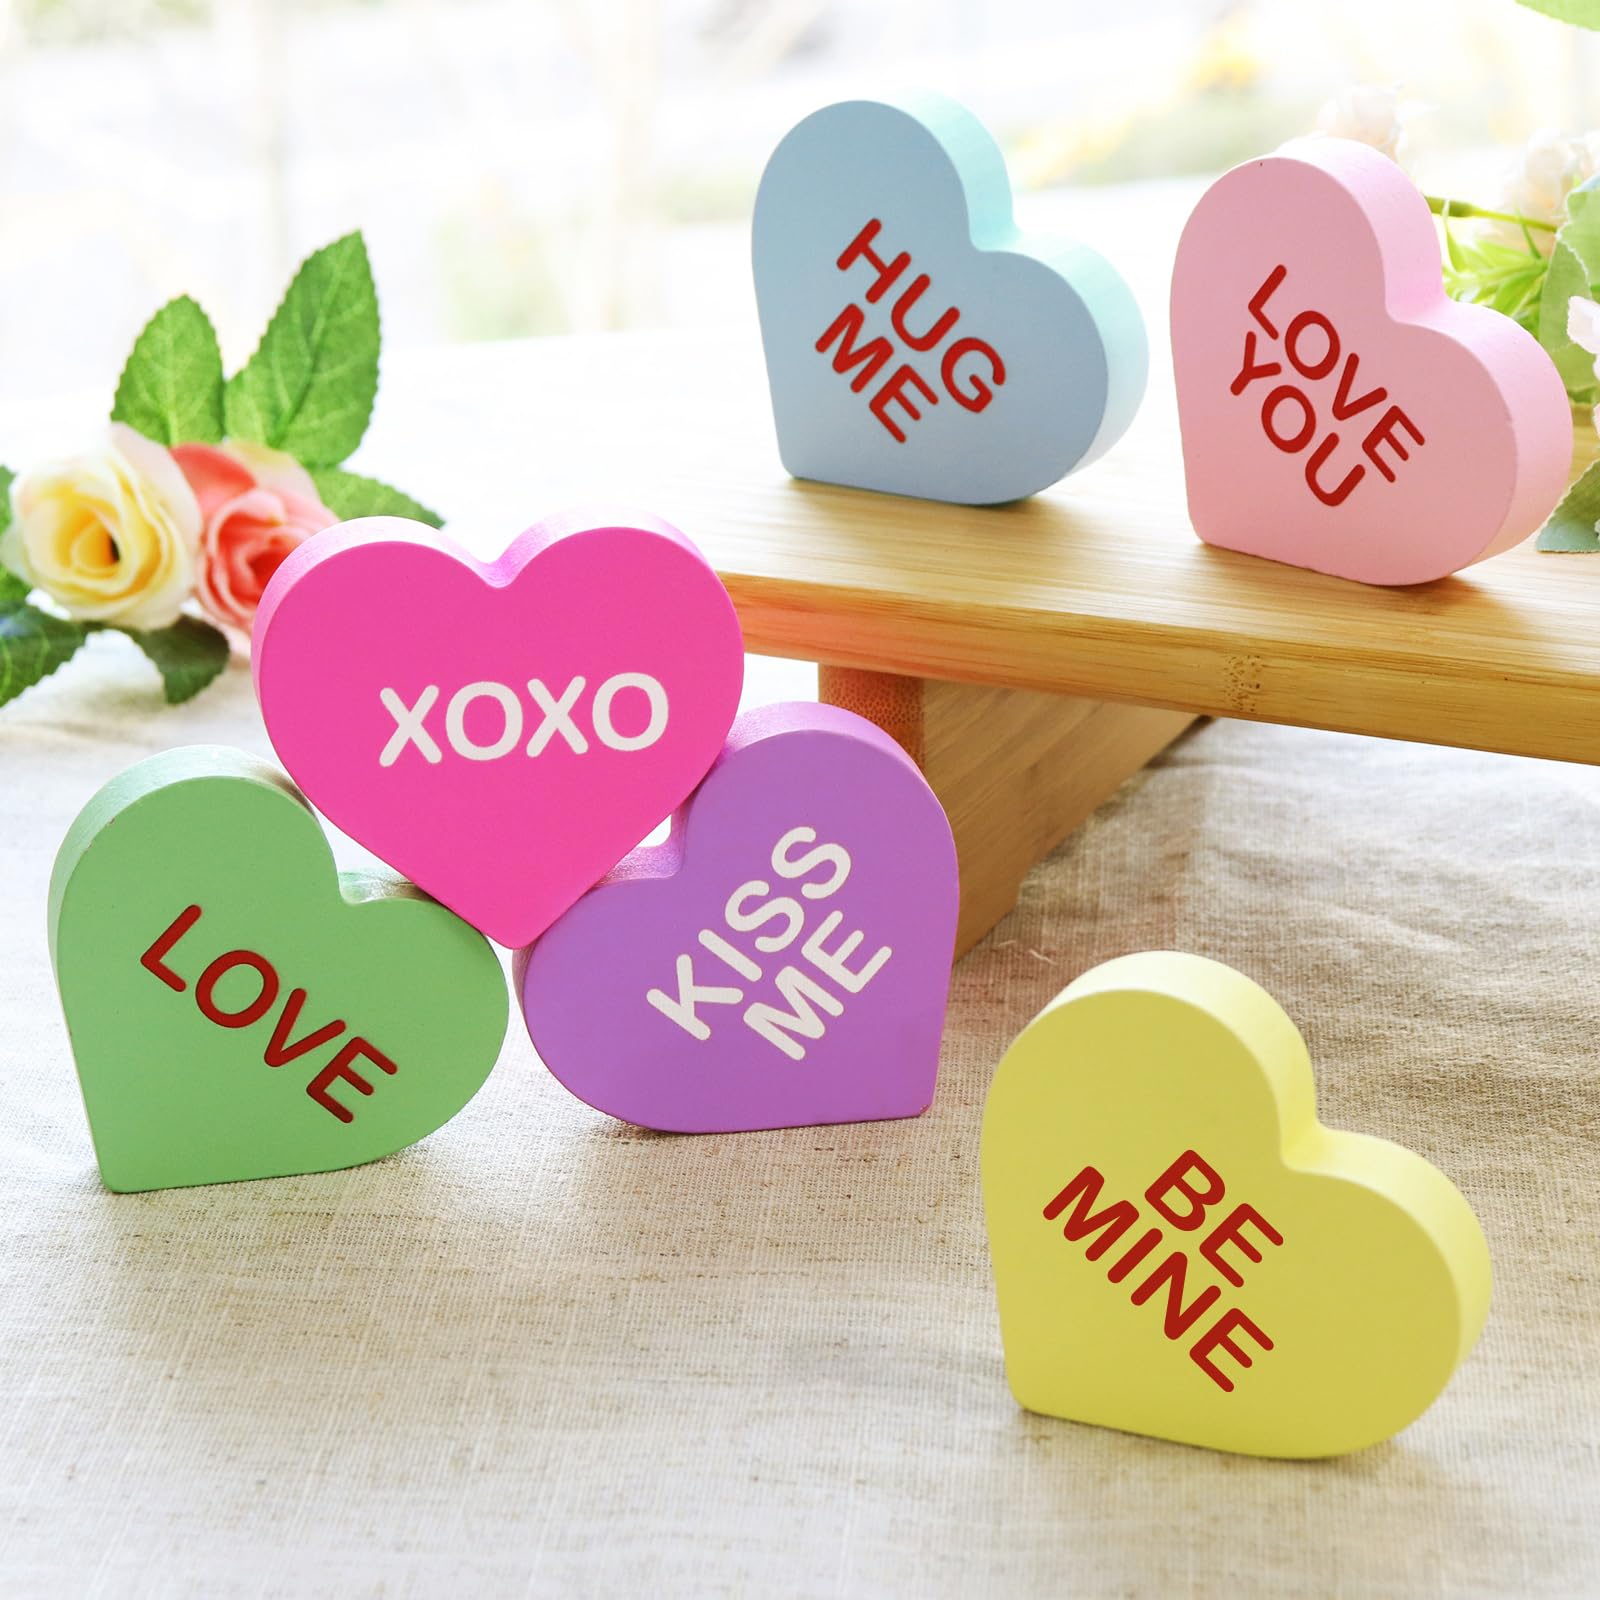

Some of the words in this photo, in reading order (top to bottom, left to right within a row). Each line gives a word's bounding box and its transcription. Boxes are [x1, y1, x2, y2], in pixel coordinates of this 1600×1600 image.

[815, 304, 938, 443] ME
[837, 218, 1006, 414] HUG
[1247, 264, 1426, 483] LOVE
[1230, 331, 1366, 508] YOU
[378, 672, 670, 768] XOXO
[140, 905, 398, 1124] LOVE
[645, 825, 852, 1041] KISS
[742, 910, 893, 1061] ME
[1042, 1165, 1274, 1393] MINE
[1144, 1149, 1284, 1288] BE
